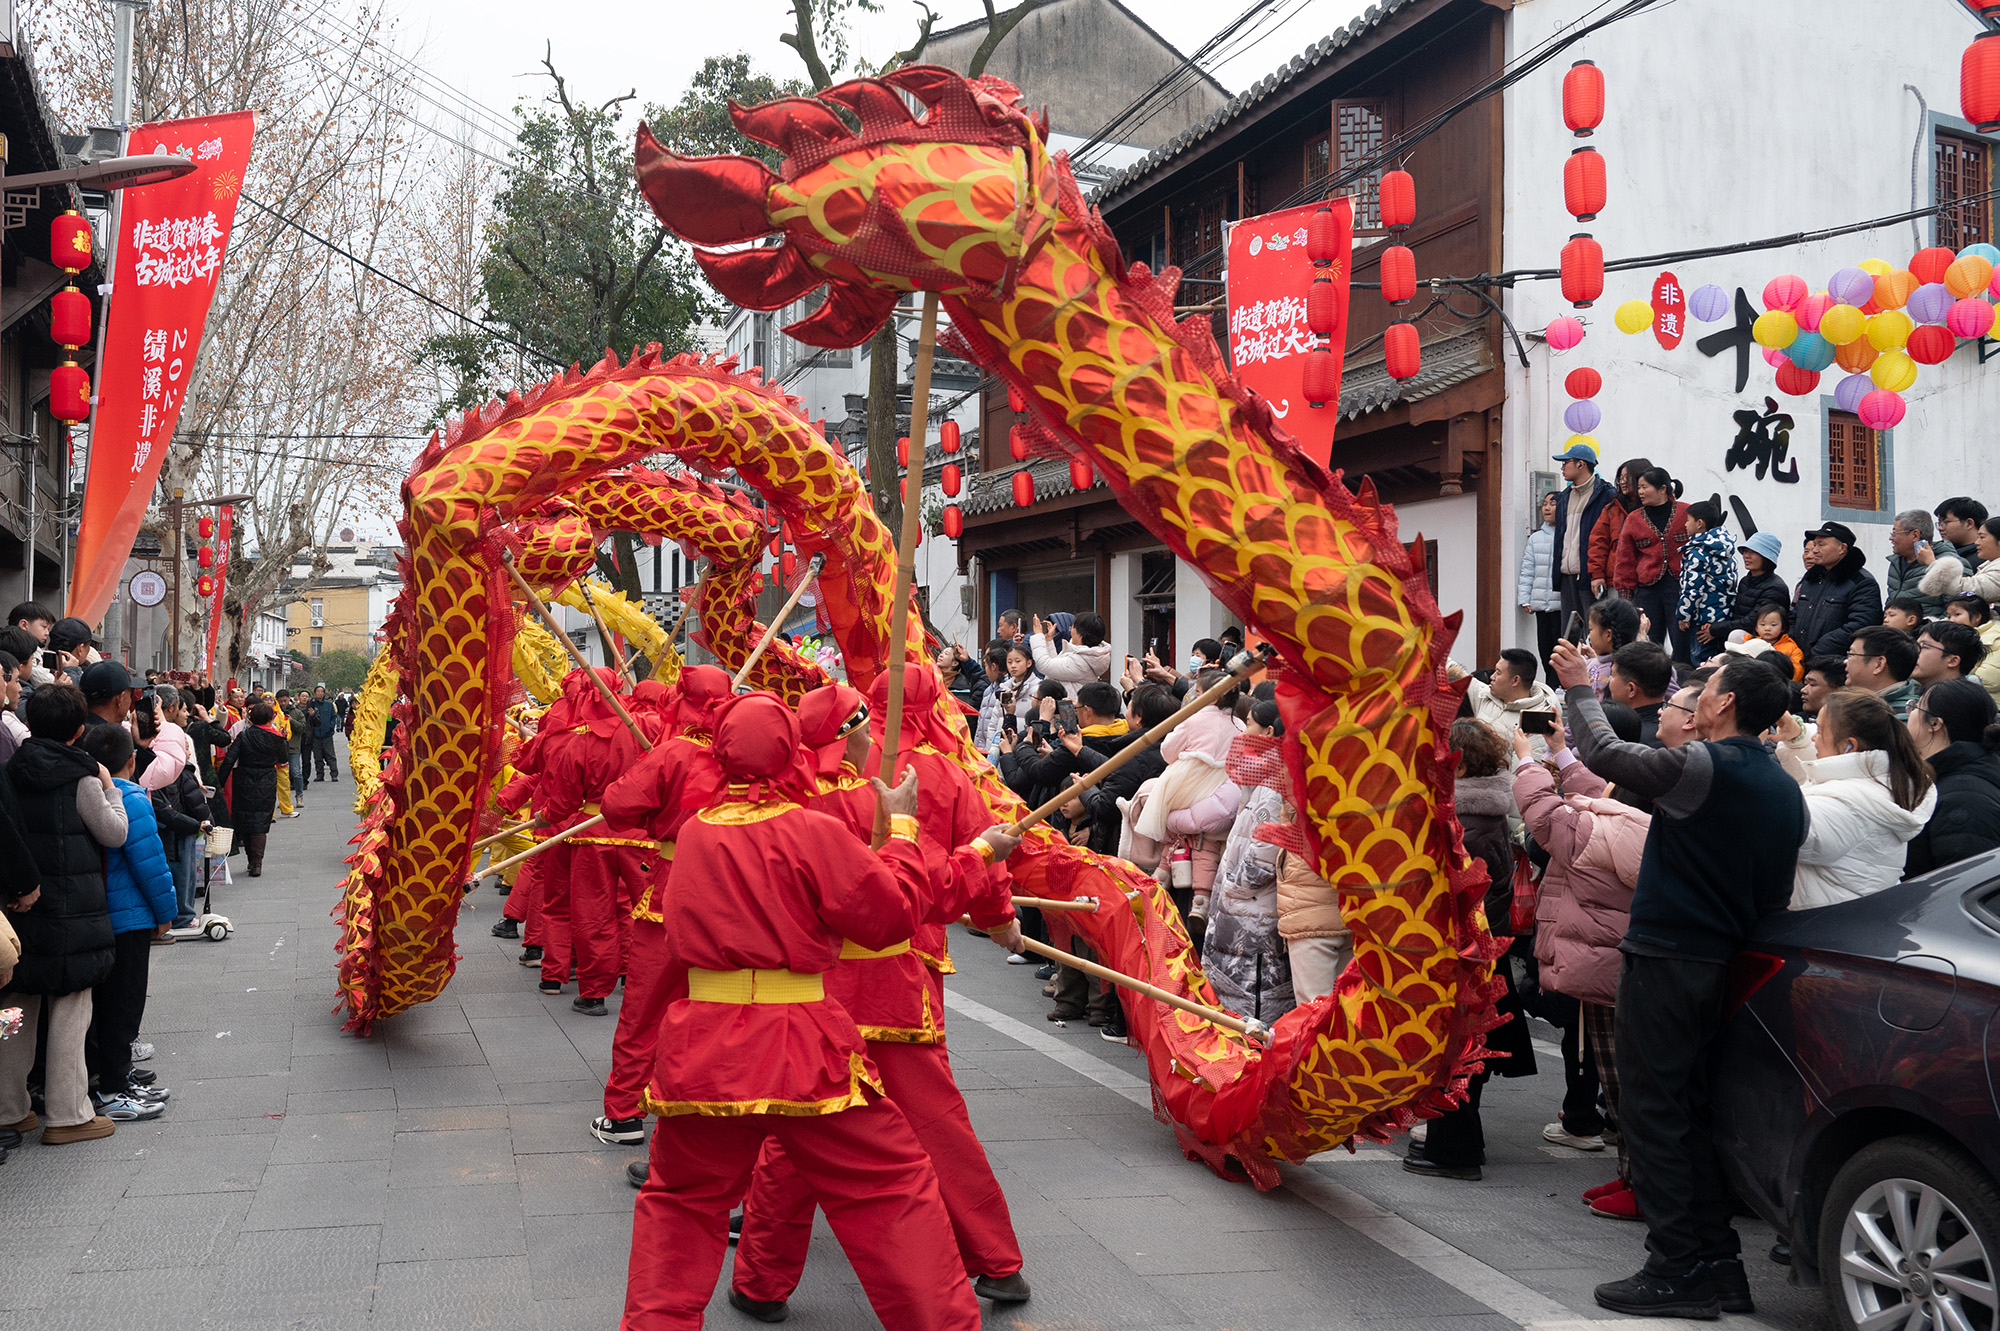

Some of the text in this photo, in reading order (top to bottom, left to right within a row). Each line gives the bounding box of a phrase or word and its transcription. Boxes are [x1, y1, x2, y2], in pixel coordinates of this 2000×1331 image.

[133, 210, 224, 256] 非遗贺新春
[135, 245, 221, 289] 古城过大年
[1660, 282, 1681, 338] 非遗
[129, 328, 168, 487] 绩溪非遗
[159, 327, 188, 432] 202
